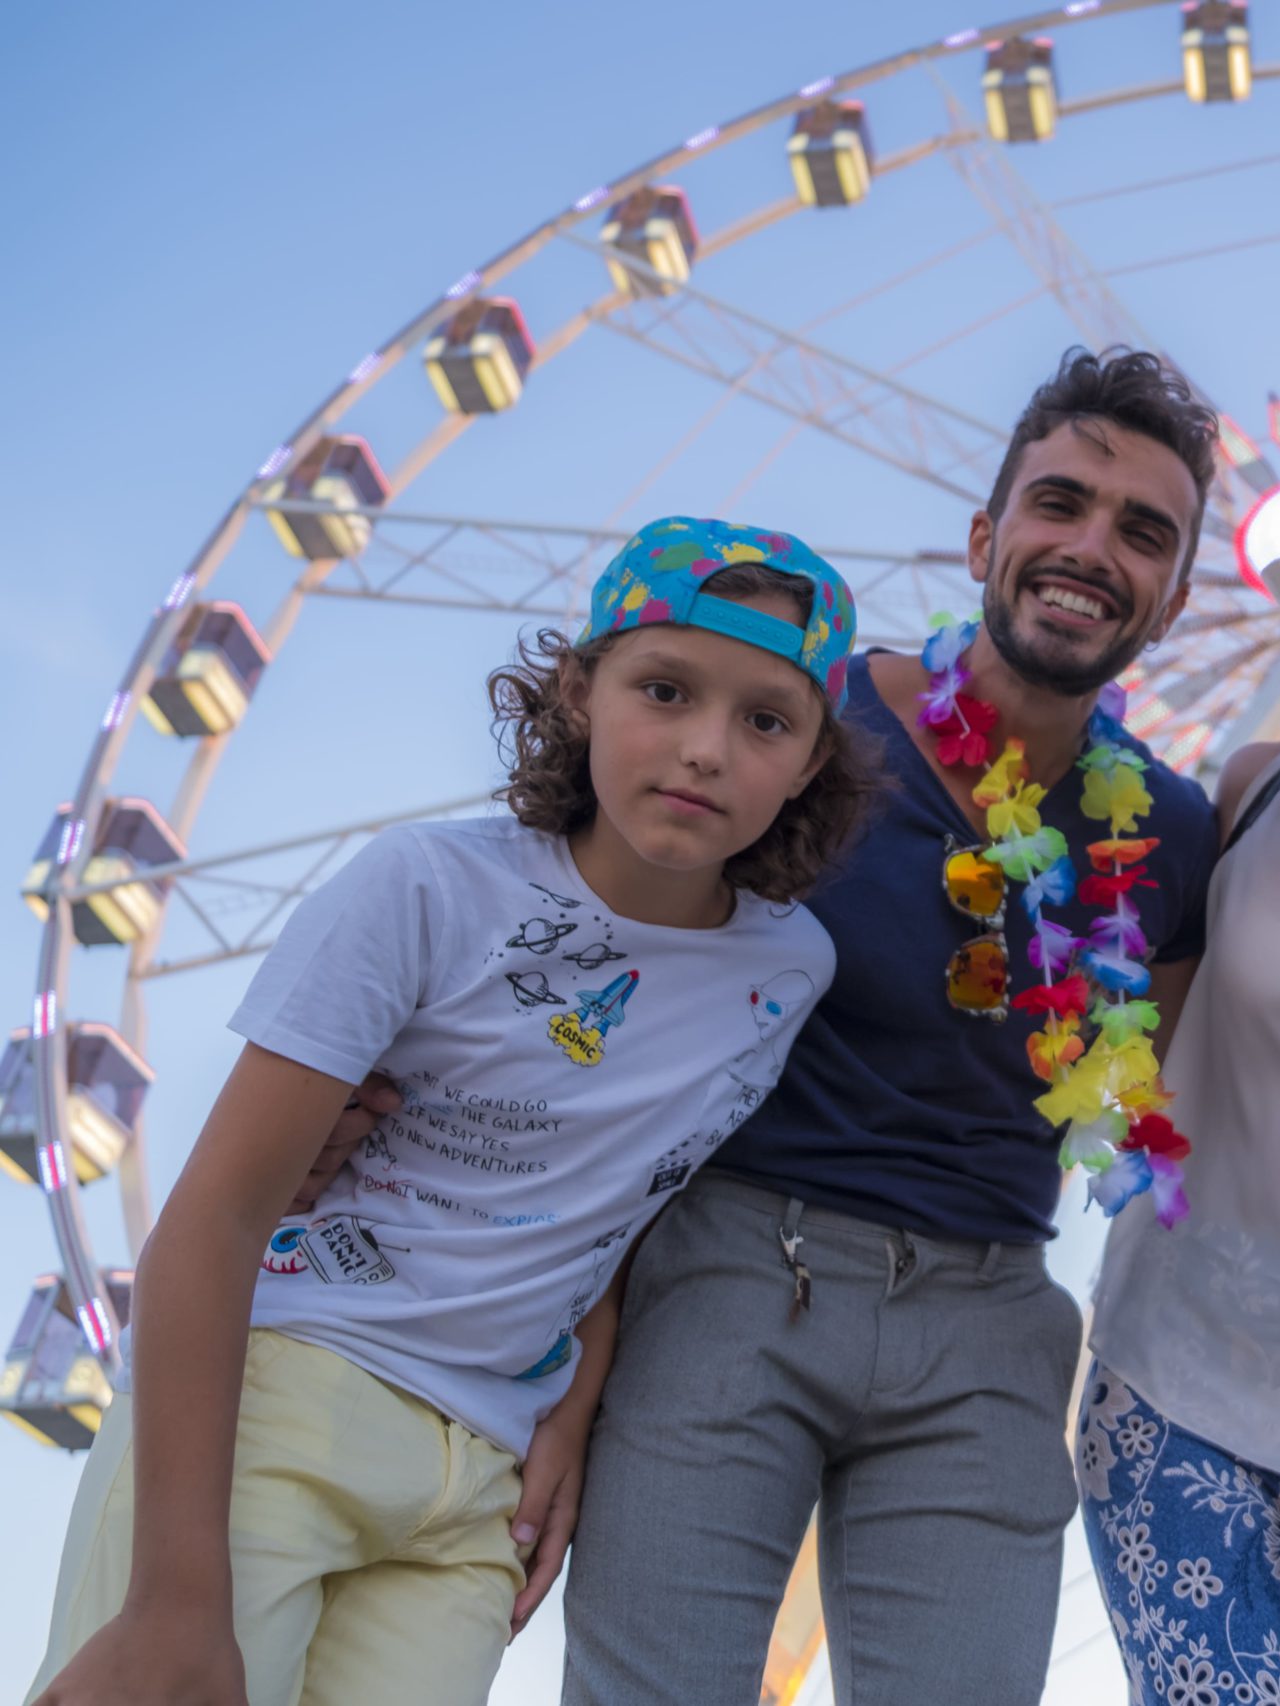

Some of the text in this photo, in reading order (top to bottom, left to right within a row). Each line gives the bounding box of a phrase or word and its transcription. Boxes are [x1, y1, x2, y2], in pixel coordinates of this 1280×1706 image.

[555, 1023, 596, 1059] COSMIC
[444, 1086, 464, 1103] WE
[468, 1094, 520, 1112] COULD
[524, 1099, 547, 1112] GO
[461, 1106, 563, 1133] THE GALAXY
[390, 1116, 548, 1174] TO NEW ADVENTURES
[405, 1105, 510, 1152] IF WE SAY YES
[320, 1227, 357, 1278] PANIC
[332, 1222, 369, 1269] DON'T
